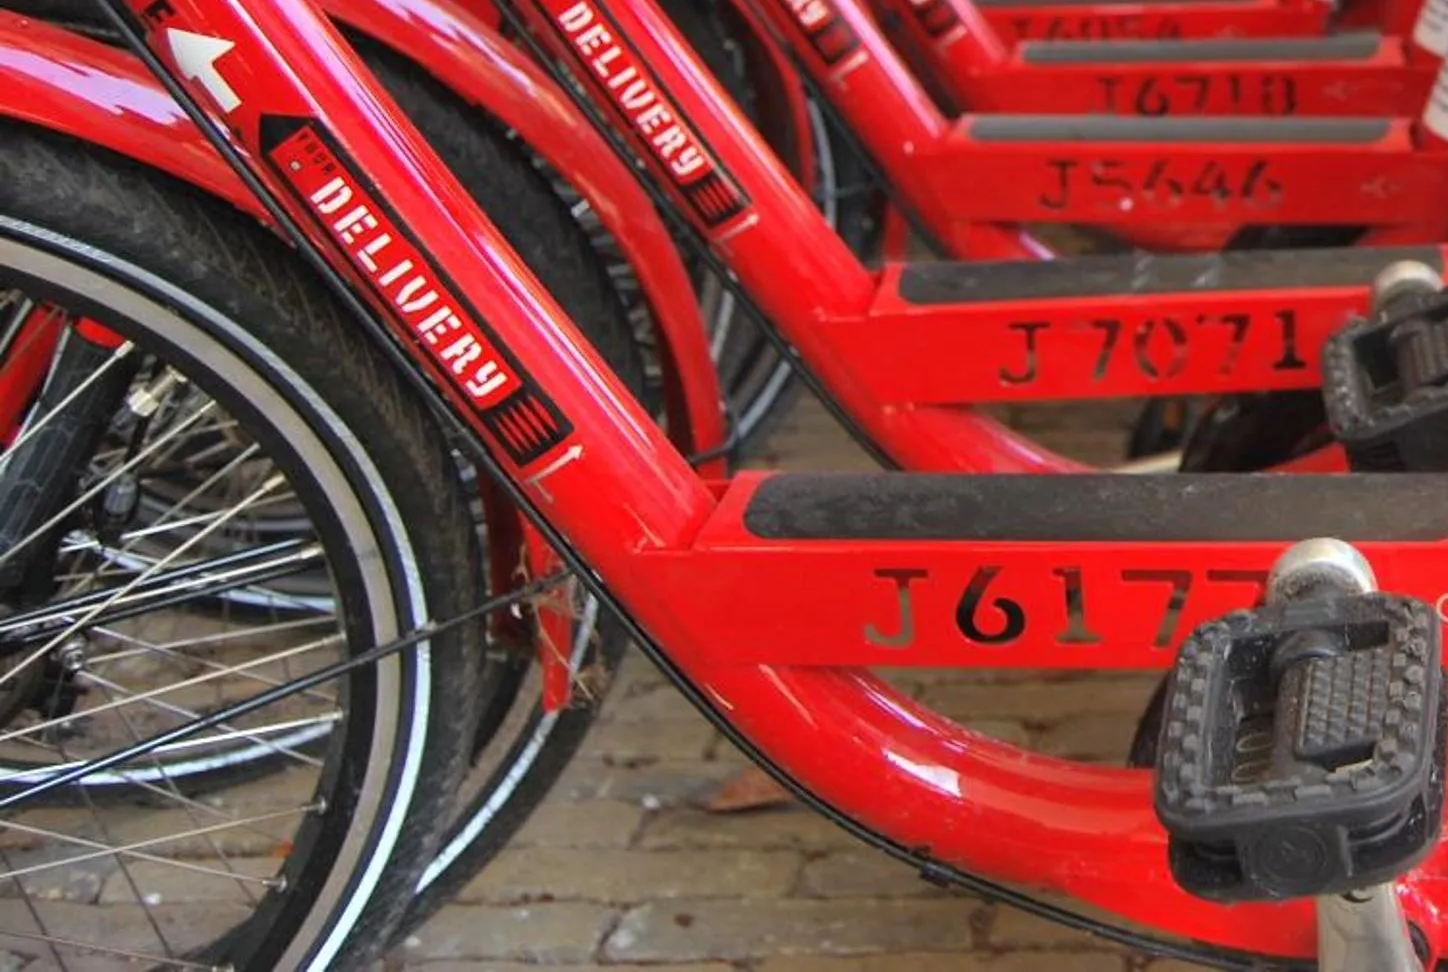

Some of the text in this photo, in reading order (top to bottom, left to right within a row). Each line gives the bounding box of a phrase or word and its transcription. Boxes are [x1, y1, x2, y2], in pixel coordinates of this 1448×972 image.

[558, 1, 704, 176] DELIVERY
[310, 176, 508, 397] DELIVERY
[999, 309, 1307, 385] J7071
